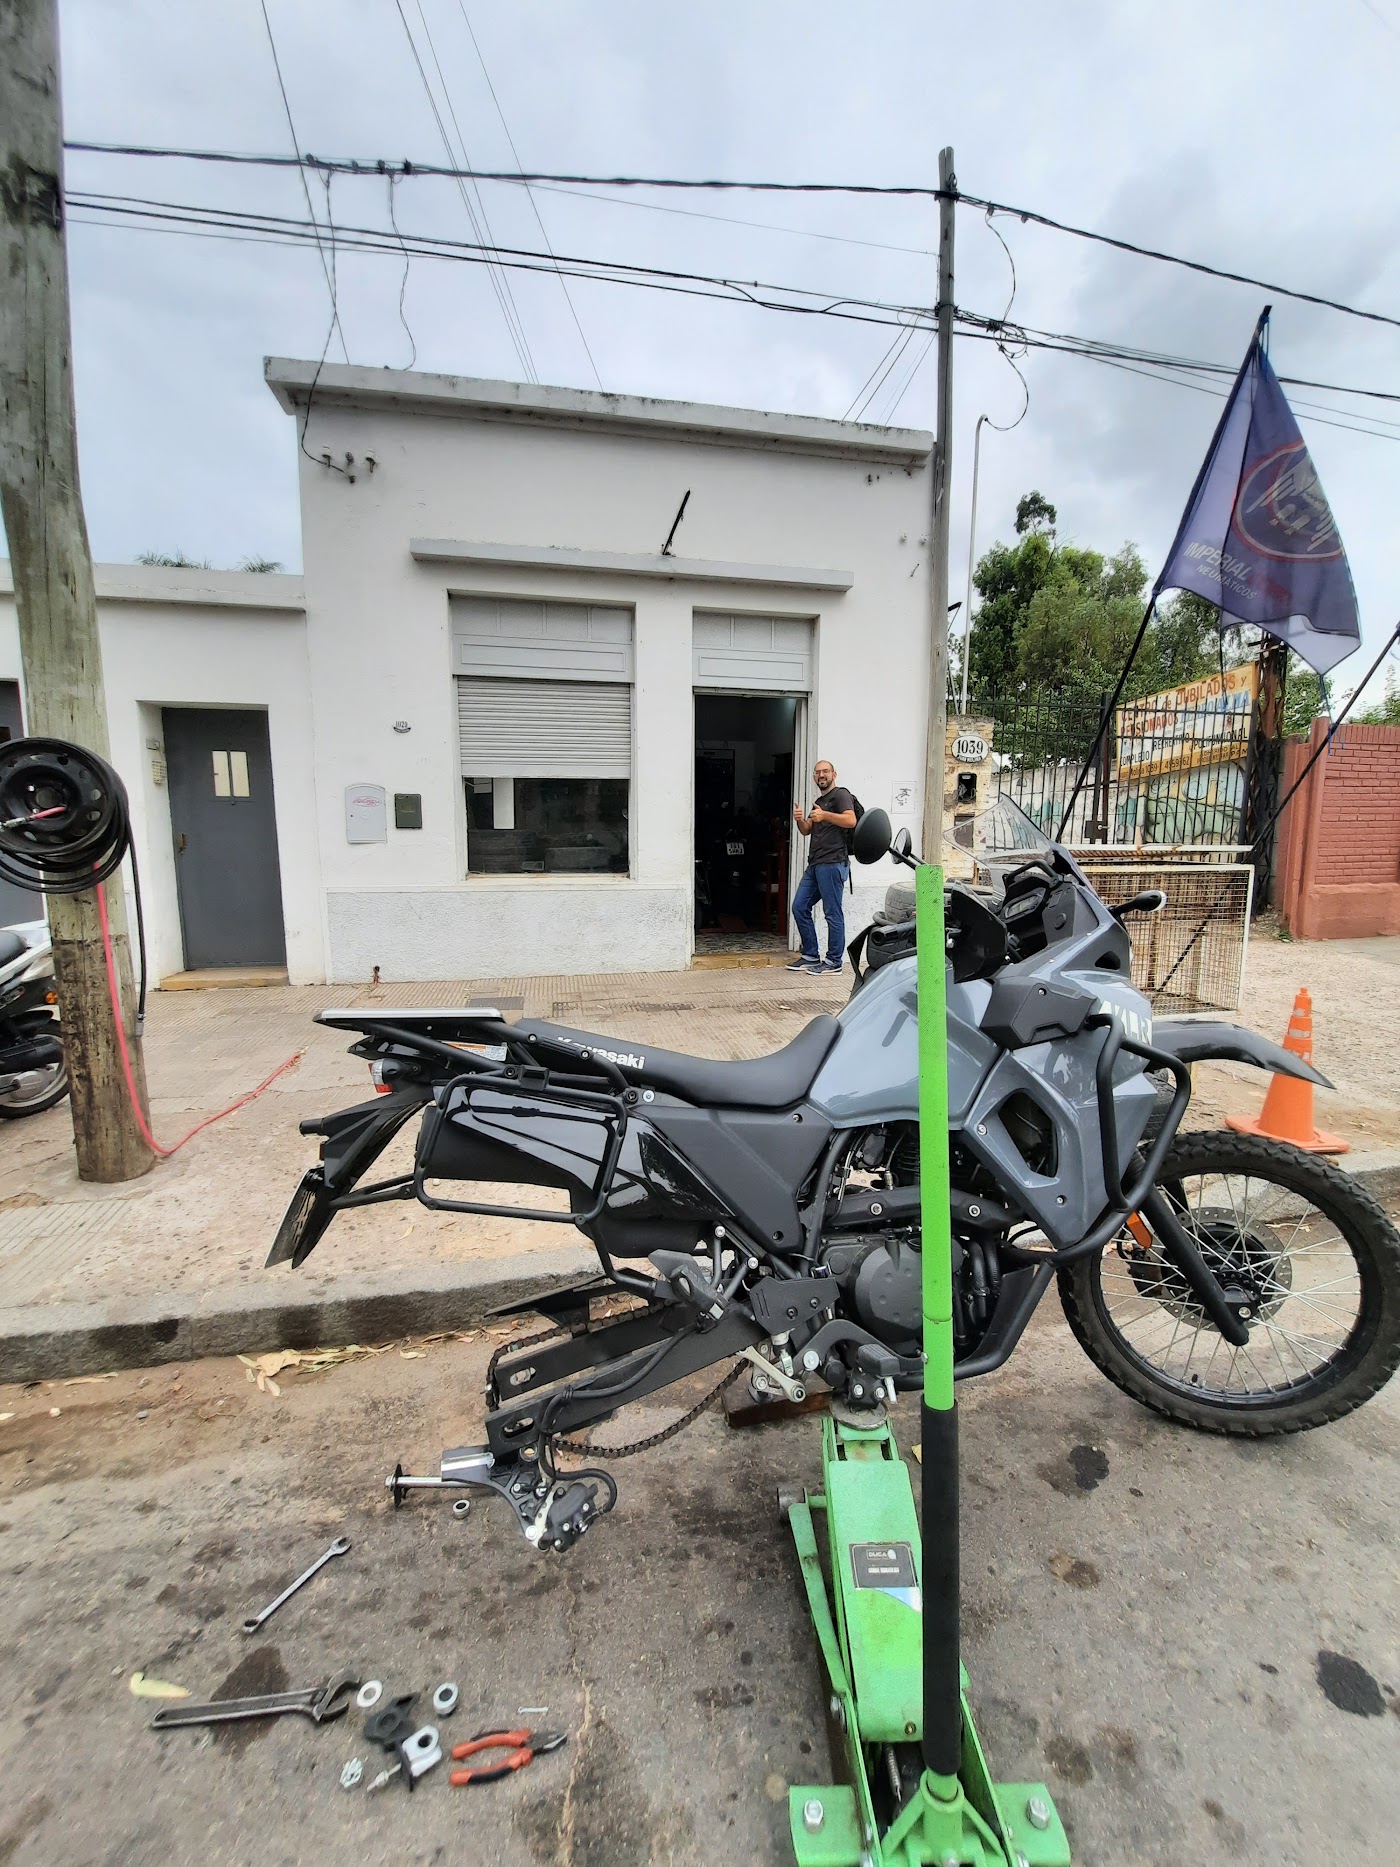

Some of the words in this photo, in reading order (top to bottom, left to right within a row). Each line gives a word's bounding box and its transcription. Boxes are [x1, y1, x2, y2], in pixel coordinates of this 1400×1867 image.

[1183, 542, 1252, 581] IMPERIAL
[1176, 674, 1236, 706] JUBILADOS
[1240, 676, 1247, 687] y
[957, 739, 984, 754] 1039
[557, 1036, 646, 1070] asaki
